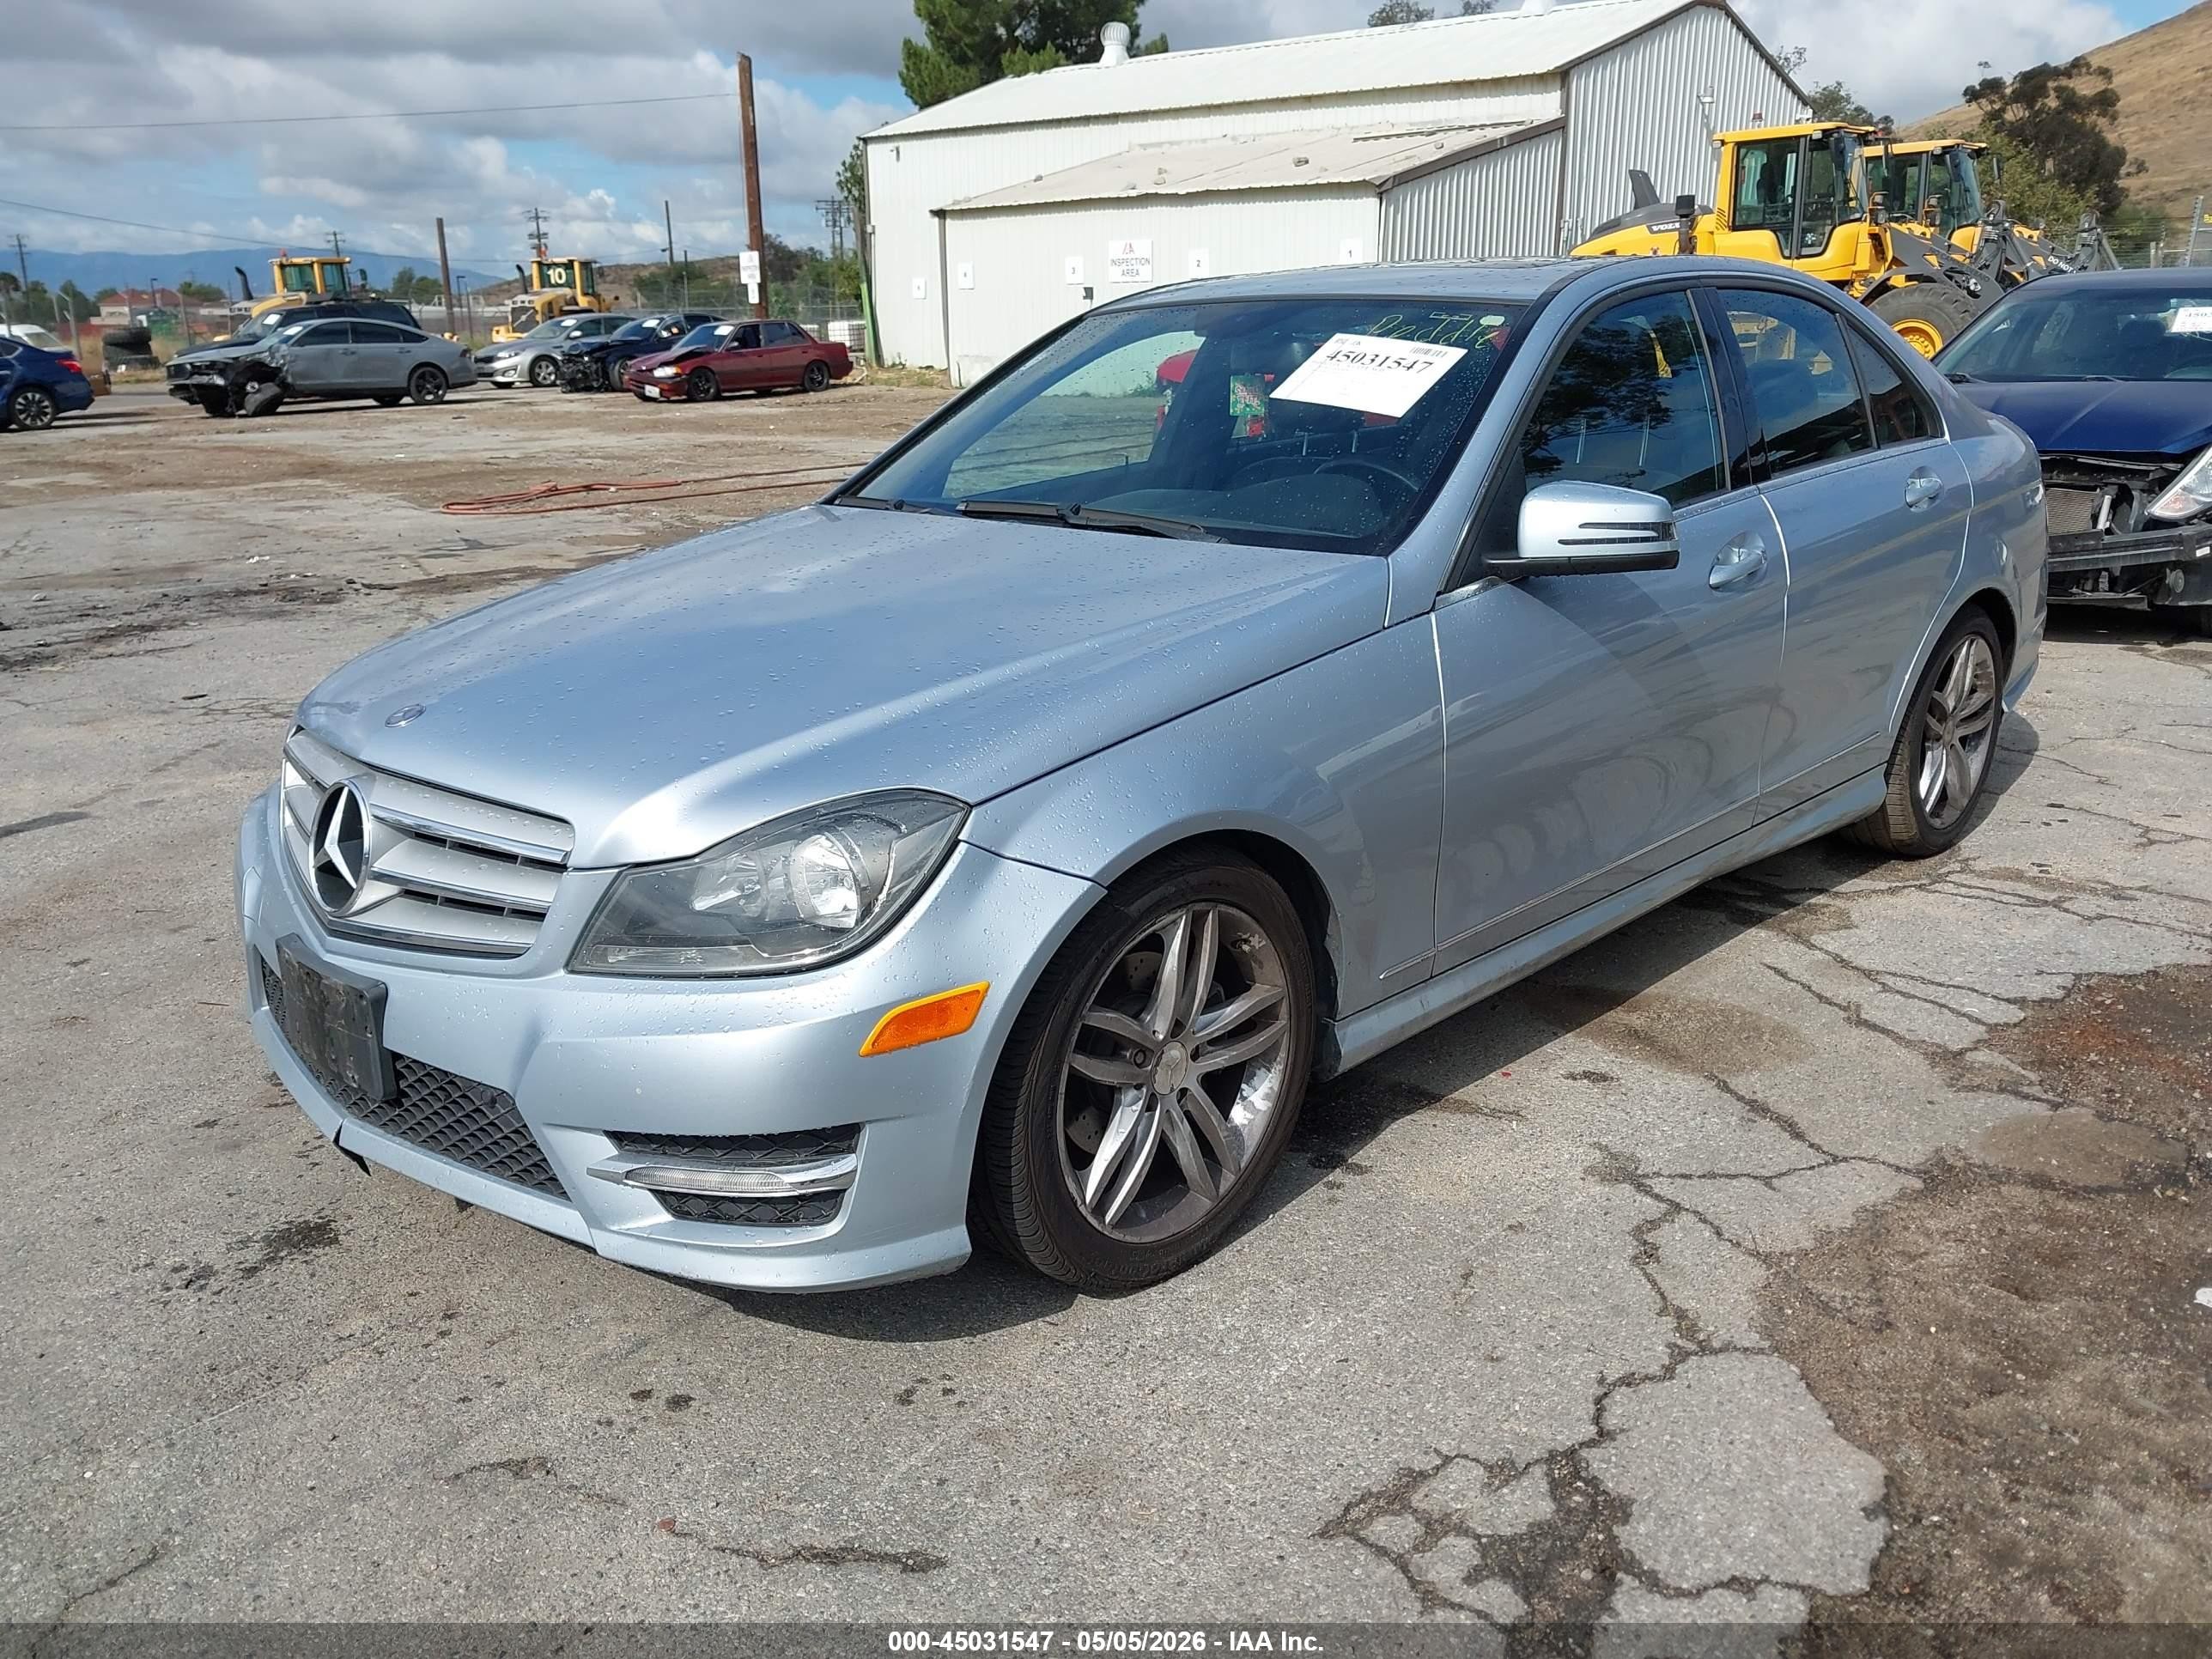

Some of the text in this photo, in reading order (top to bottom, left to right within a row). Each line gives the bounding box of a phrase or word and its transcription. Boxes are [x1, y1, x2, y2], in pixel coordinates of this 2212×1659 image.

[1110, 258, 1151, 266] INSPECTION
[2048, 256, 2074, 273] DO NOT
[546, 267, 567, 285] 10
[1121, 268, 1140, 276] AREA
[1327, 349, 1433, 374] 45031547
